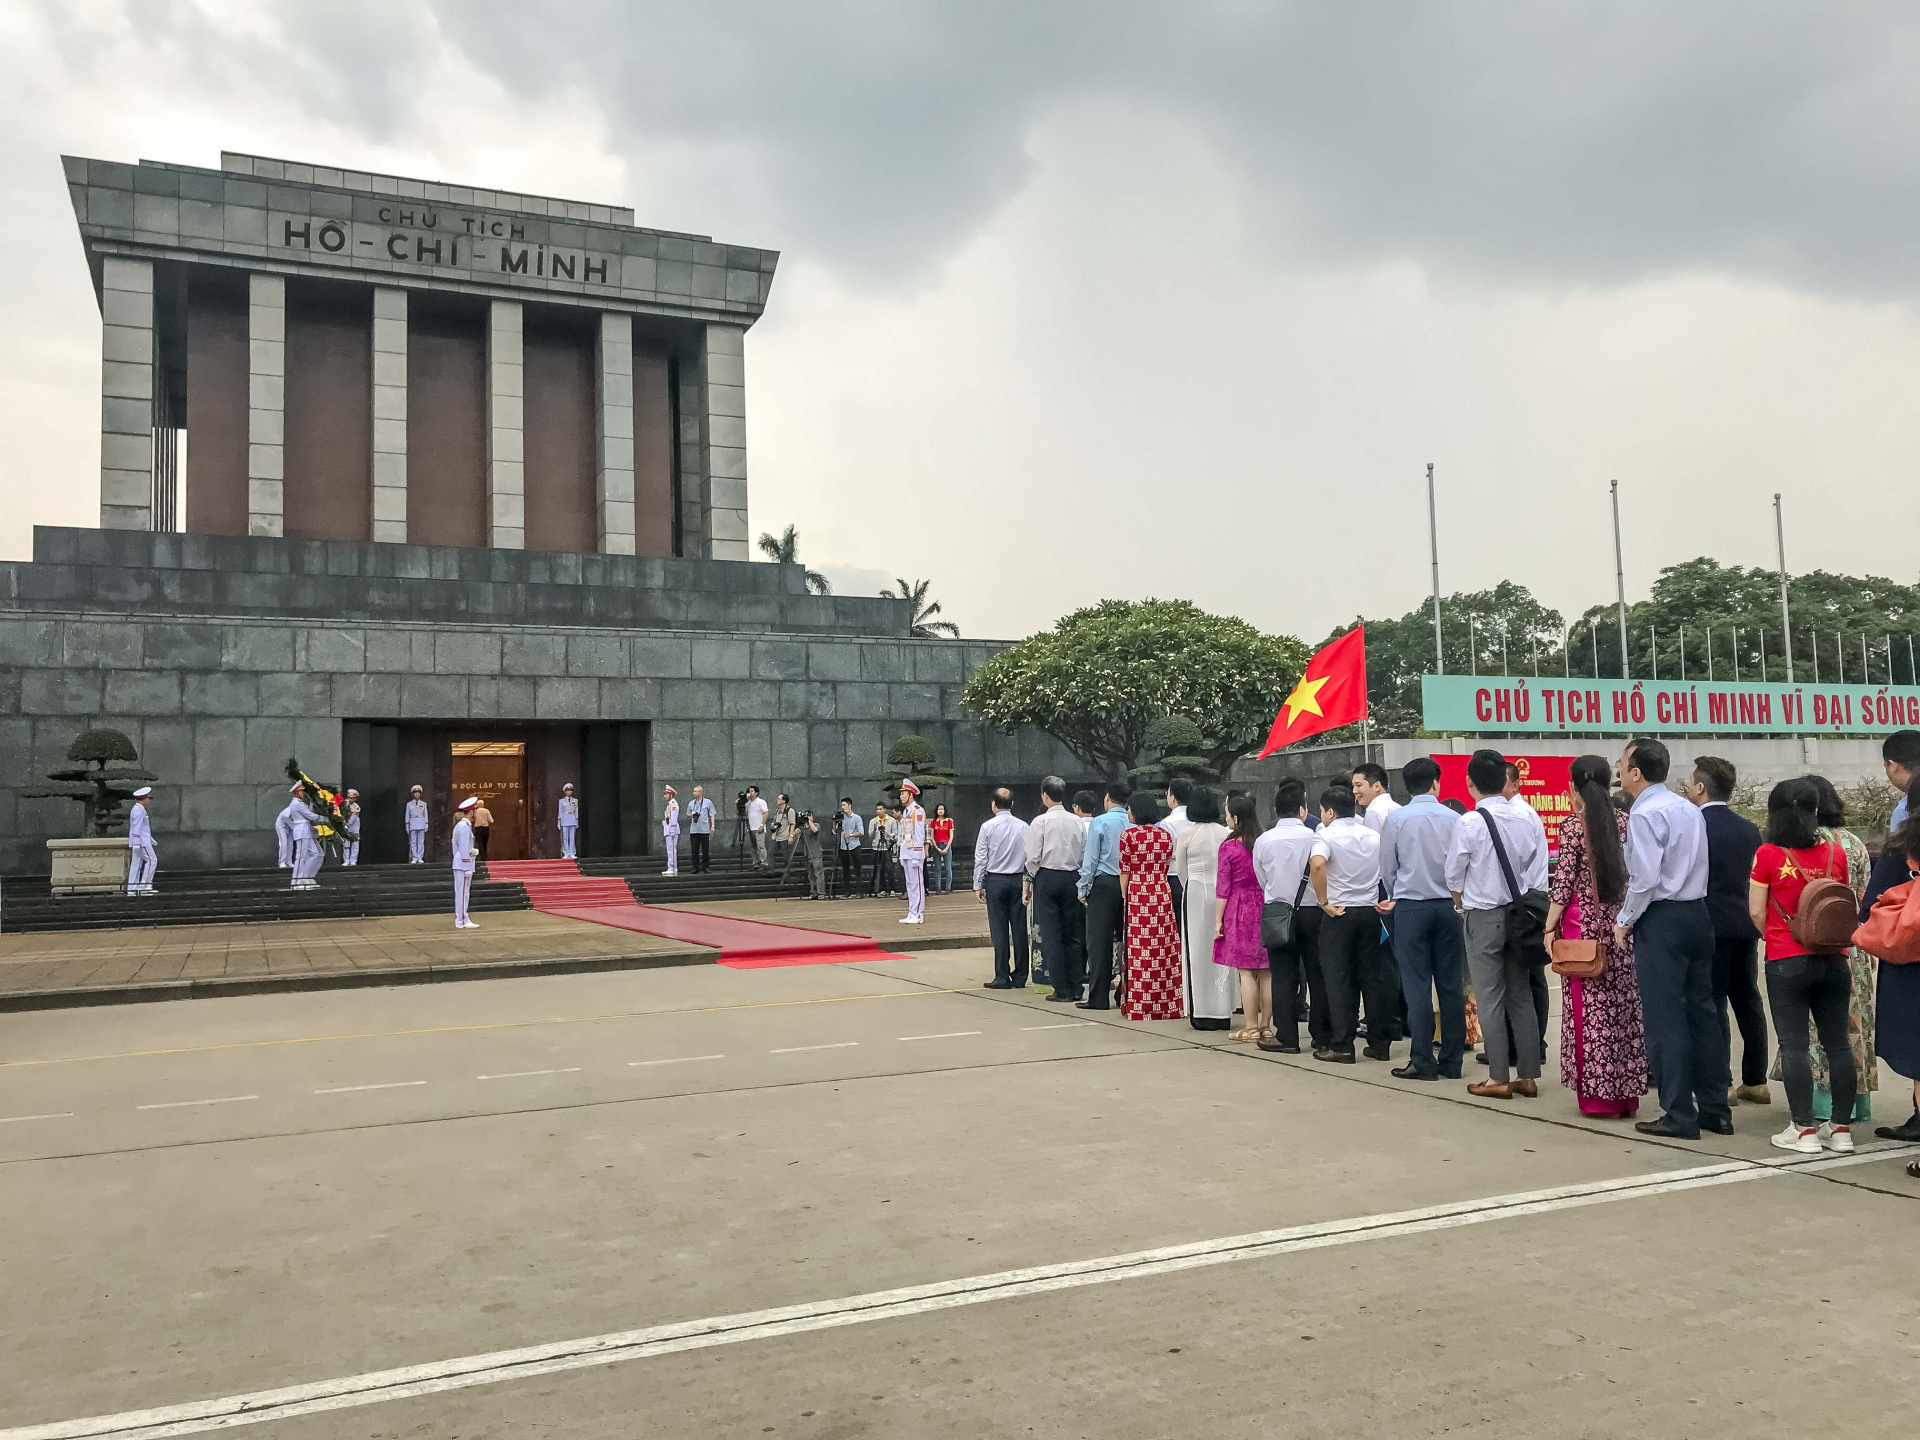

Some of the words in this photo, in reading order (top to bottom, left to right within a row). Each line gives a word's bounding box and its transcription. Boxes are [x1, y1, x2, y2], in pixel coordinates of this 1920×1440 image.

[284, 219, 348, 253] HỒ
[1475, 678, 1531, 722] CHỦ
[1541, 689, 1601, 729] TỊCH
[1612, 681, 1646, 723] HỒ
[1656, 685, 1698, 724] CHÍ
[1708, 692, 1772, 725] MINH
[1781, 688, 1804, 725] VĨ
[1813, 694, 1852, 730] ĐẠI
[1861, 687, 1920, 726] SỐNG
